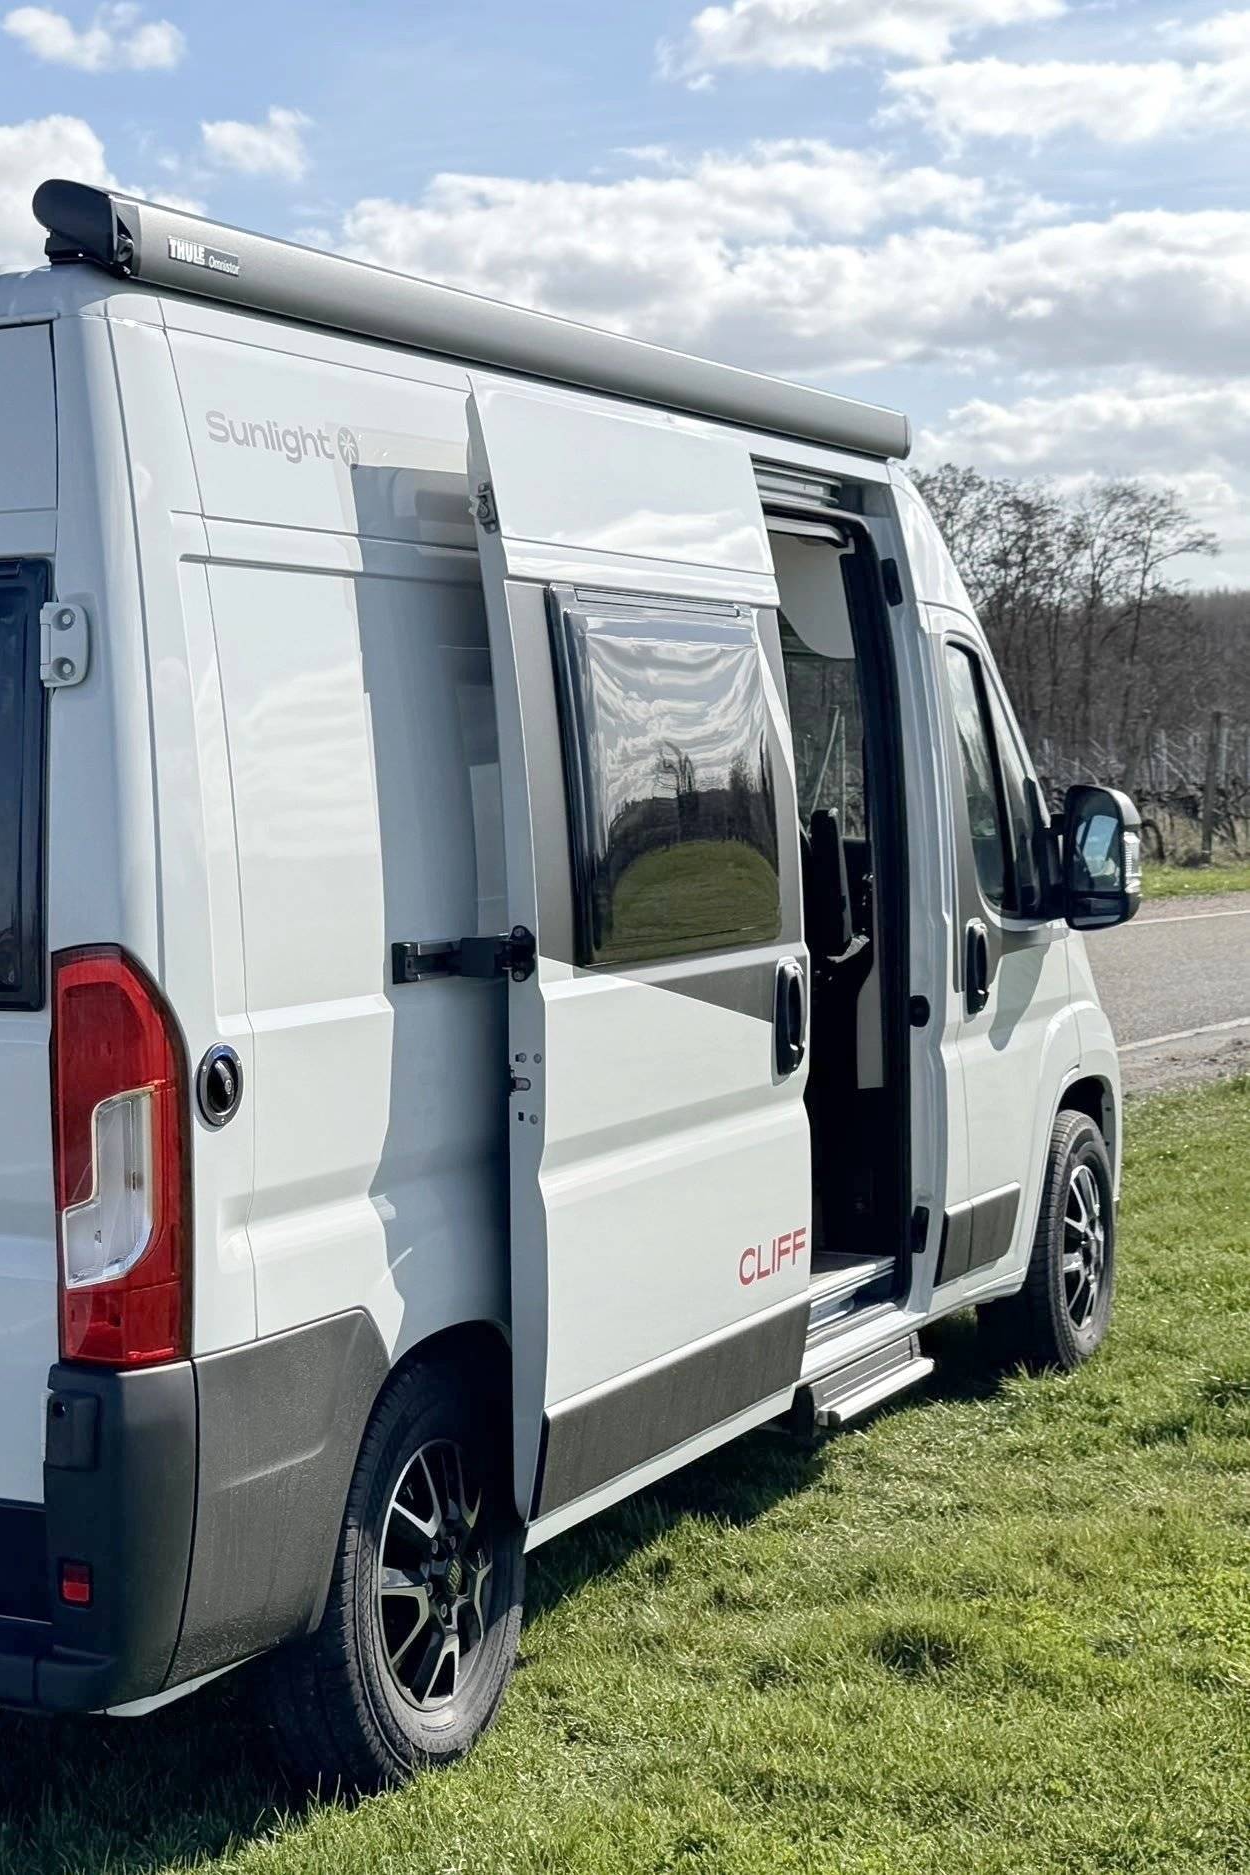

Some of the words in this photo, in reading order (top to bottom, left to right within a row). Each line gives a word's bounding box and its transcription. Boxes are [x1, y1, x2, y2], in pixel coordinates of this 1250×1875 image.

[168, 237, 206, 266] THULE
[208, 255, 240, 275] Omnistor
[205, 410, 335, 464] Sunlight
[739, 1227, 807, 1286] CLIFF
